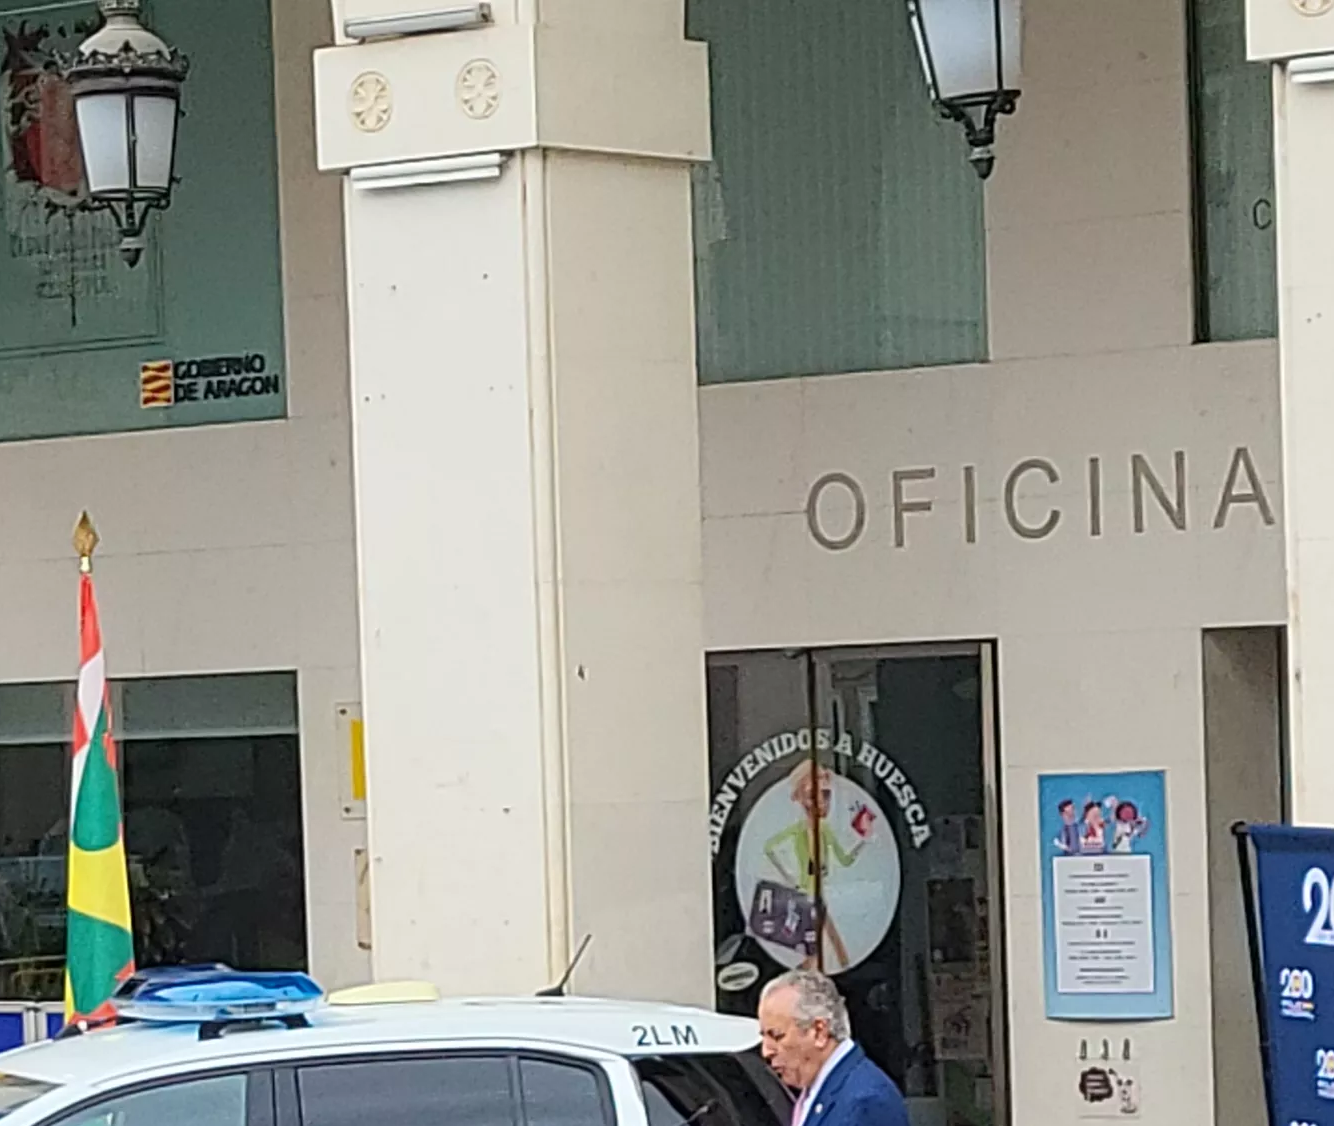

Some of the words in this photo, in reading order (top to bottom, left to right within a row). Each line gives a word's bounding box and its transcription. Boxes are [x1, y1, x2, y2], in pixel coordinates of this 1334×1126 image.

[174, 353, 266, 380] GOBIERNO
[174, 381, 200, 403] DE
[203, 373, 280, 400] ARAGON
[804, 446, 1276, 551] OFICINA
[857, 740, 933, 849] HUESCA
[631, 1024, 699, 1047] 2LM
